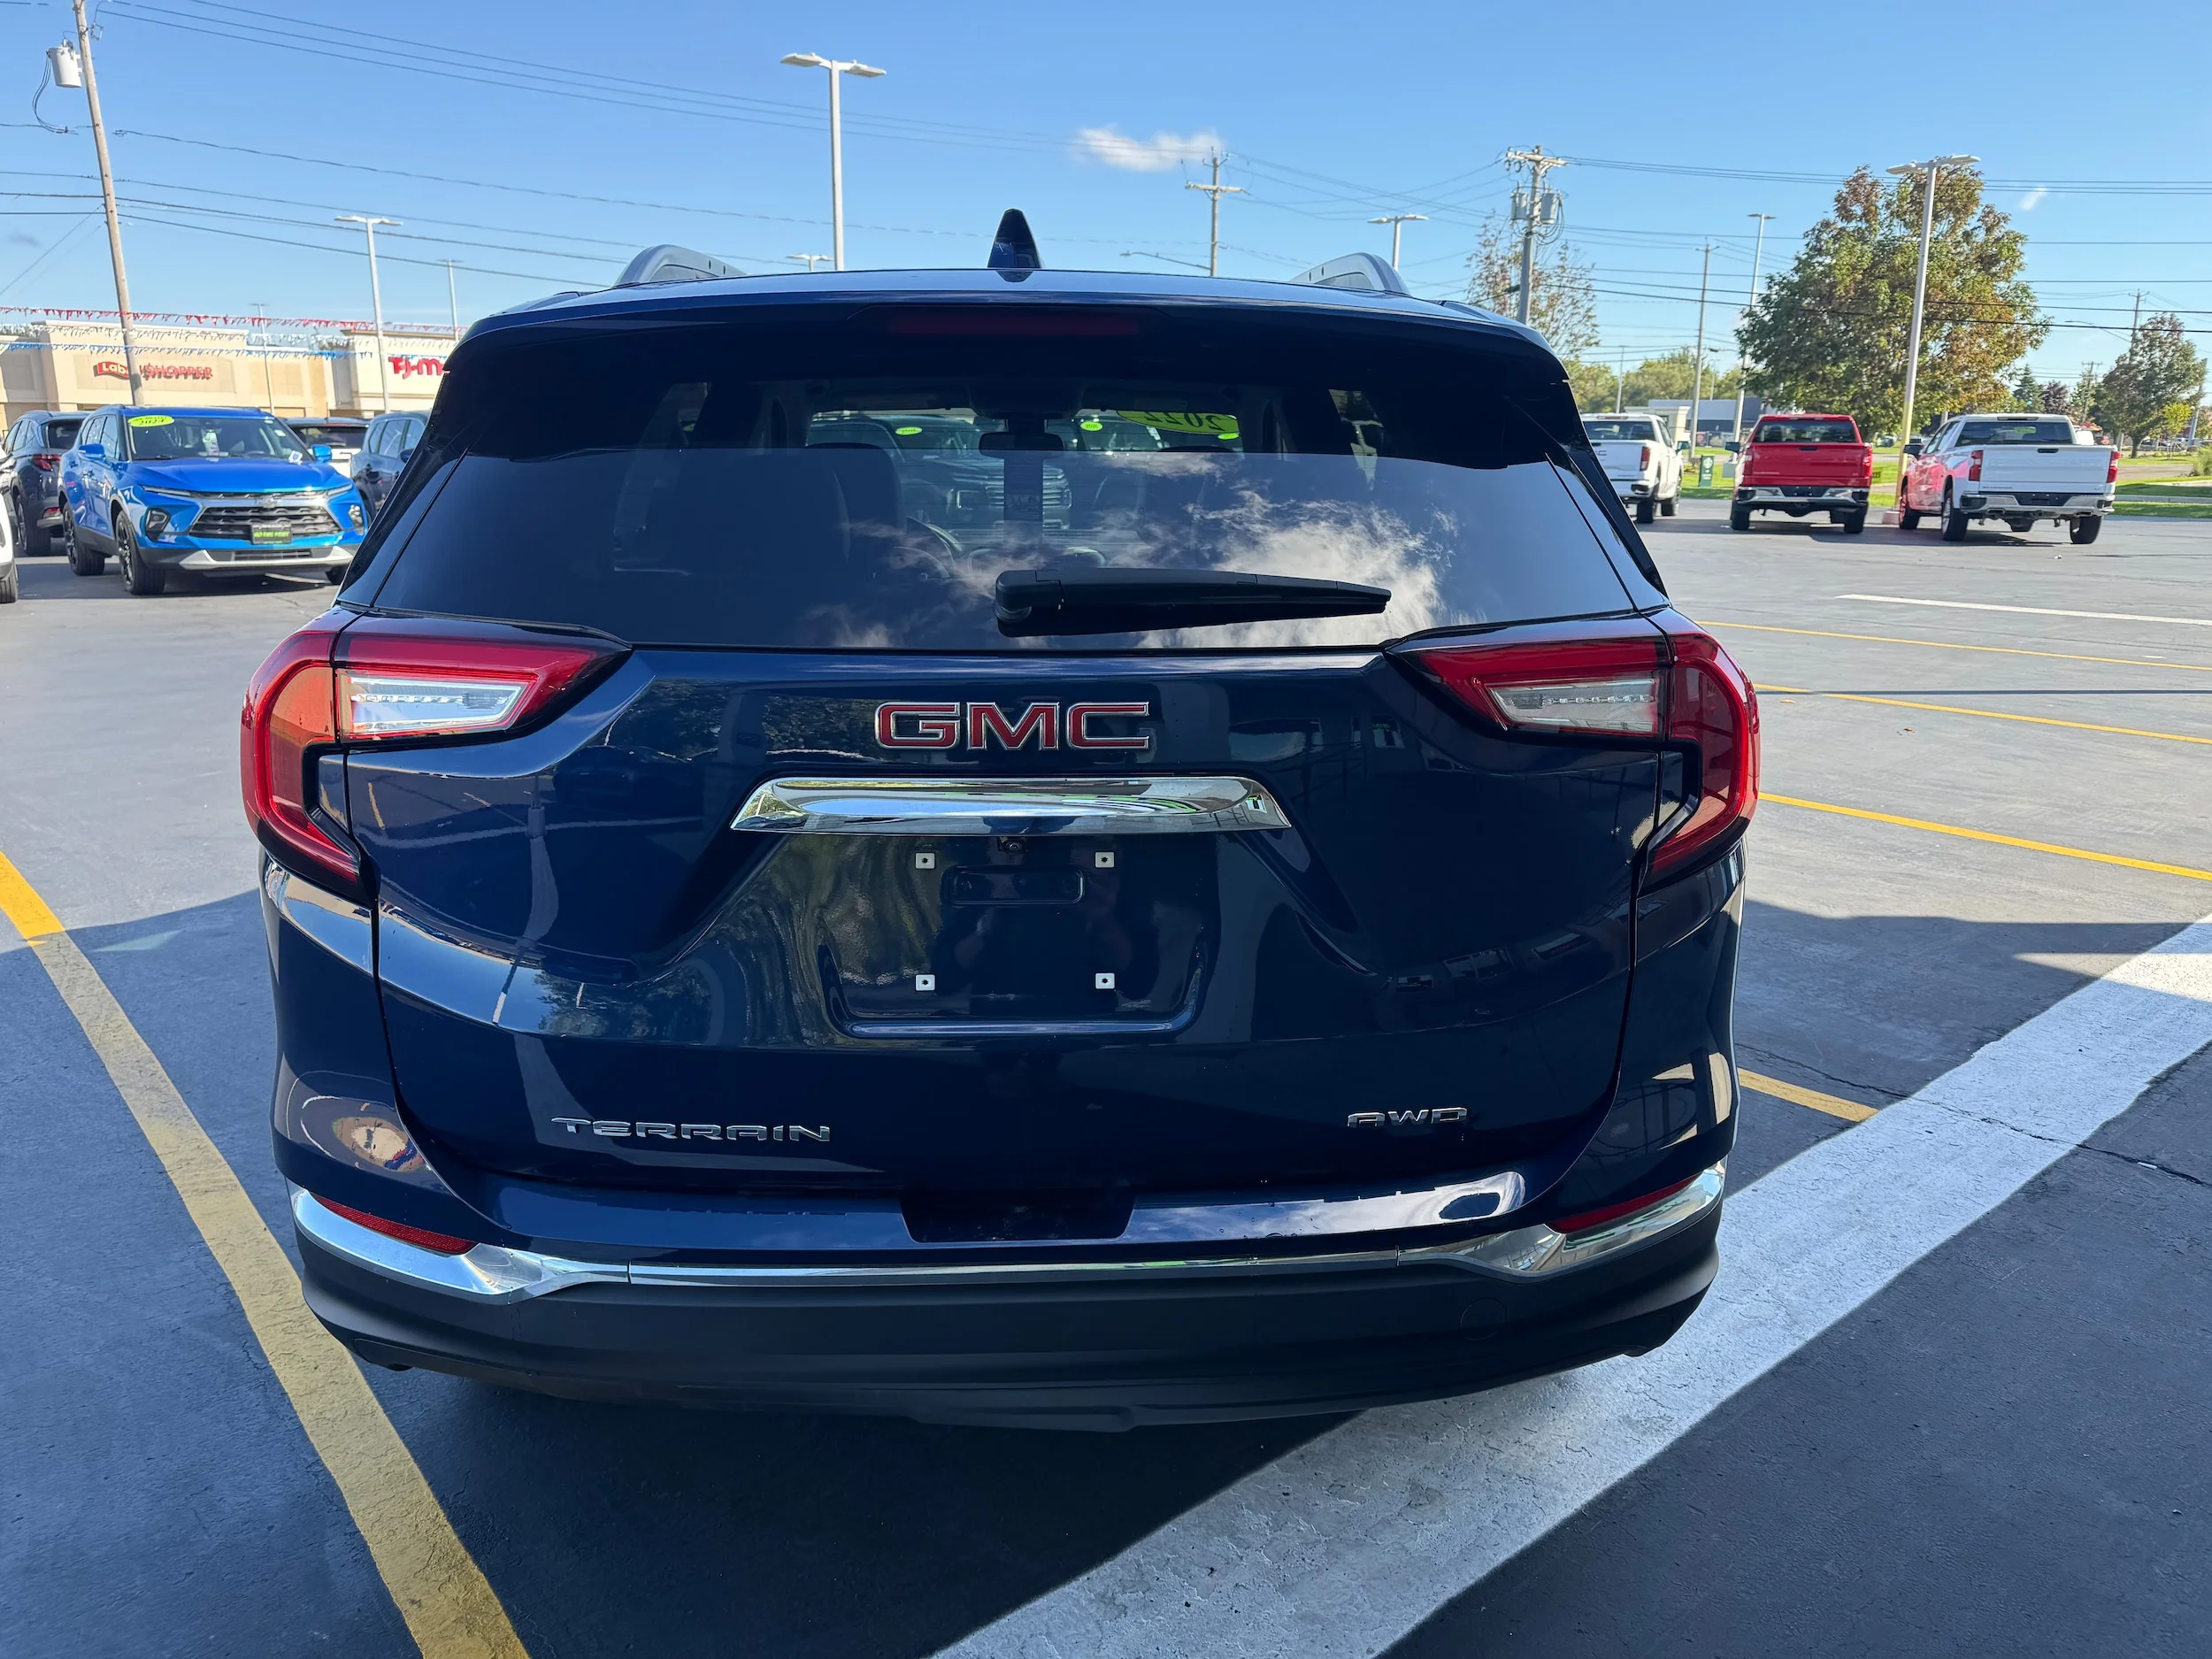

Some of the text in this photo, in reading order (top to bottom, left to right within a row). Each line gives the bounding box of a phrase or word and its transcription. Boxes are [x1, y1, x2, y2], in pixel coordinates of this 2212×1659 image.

[874, 702, 1149, 750] GMC
[1347, 1107, 1468, 1128] AWD
[551, 1118, 830, 1141] TERRAIN
